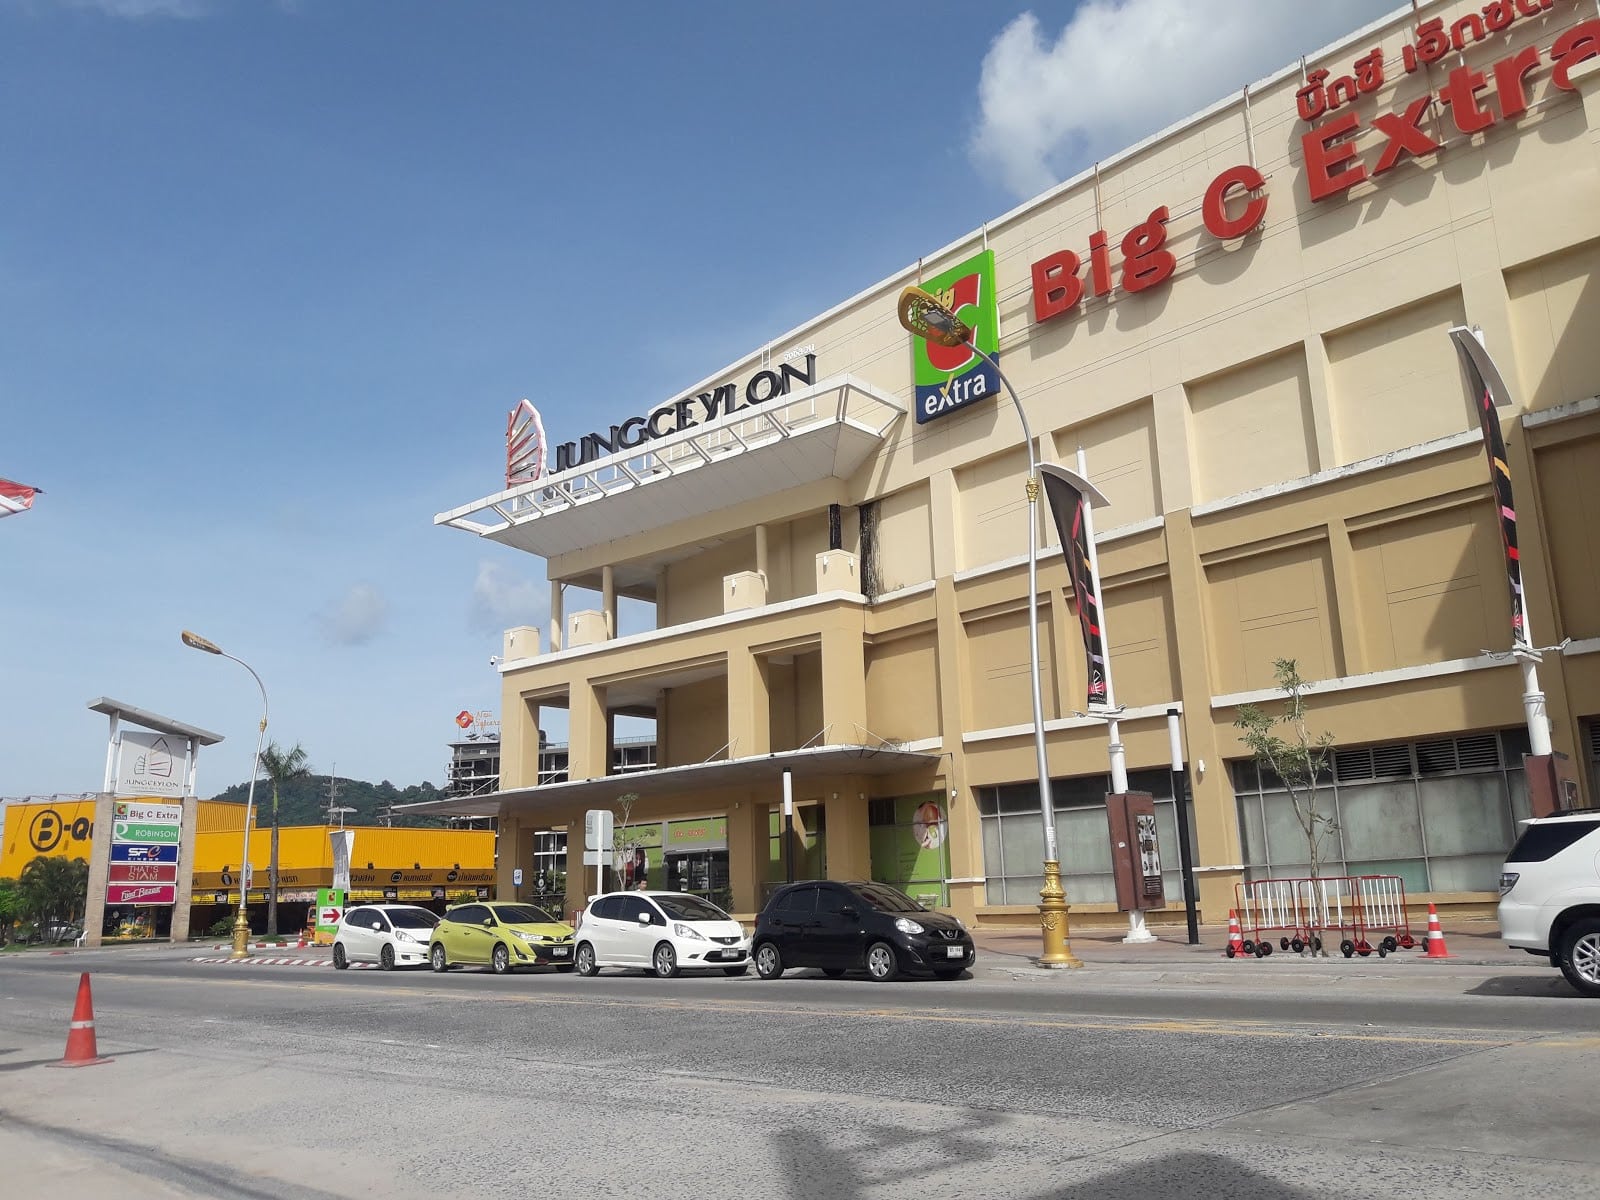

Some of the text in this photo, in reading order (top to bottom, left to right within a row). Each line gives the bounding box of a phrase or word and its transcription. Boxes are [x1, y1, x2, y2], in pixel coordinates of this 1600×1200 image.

[1031, 19, 1600, 324] Big C Extra
[549, 353, 817, 475] JUNGCEYLON
[130, 810, 144, 819] Big
[156, 811, 178, 819] Extra
[135, 829, 177, 838] ROBINSON
